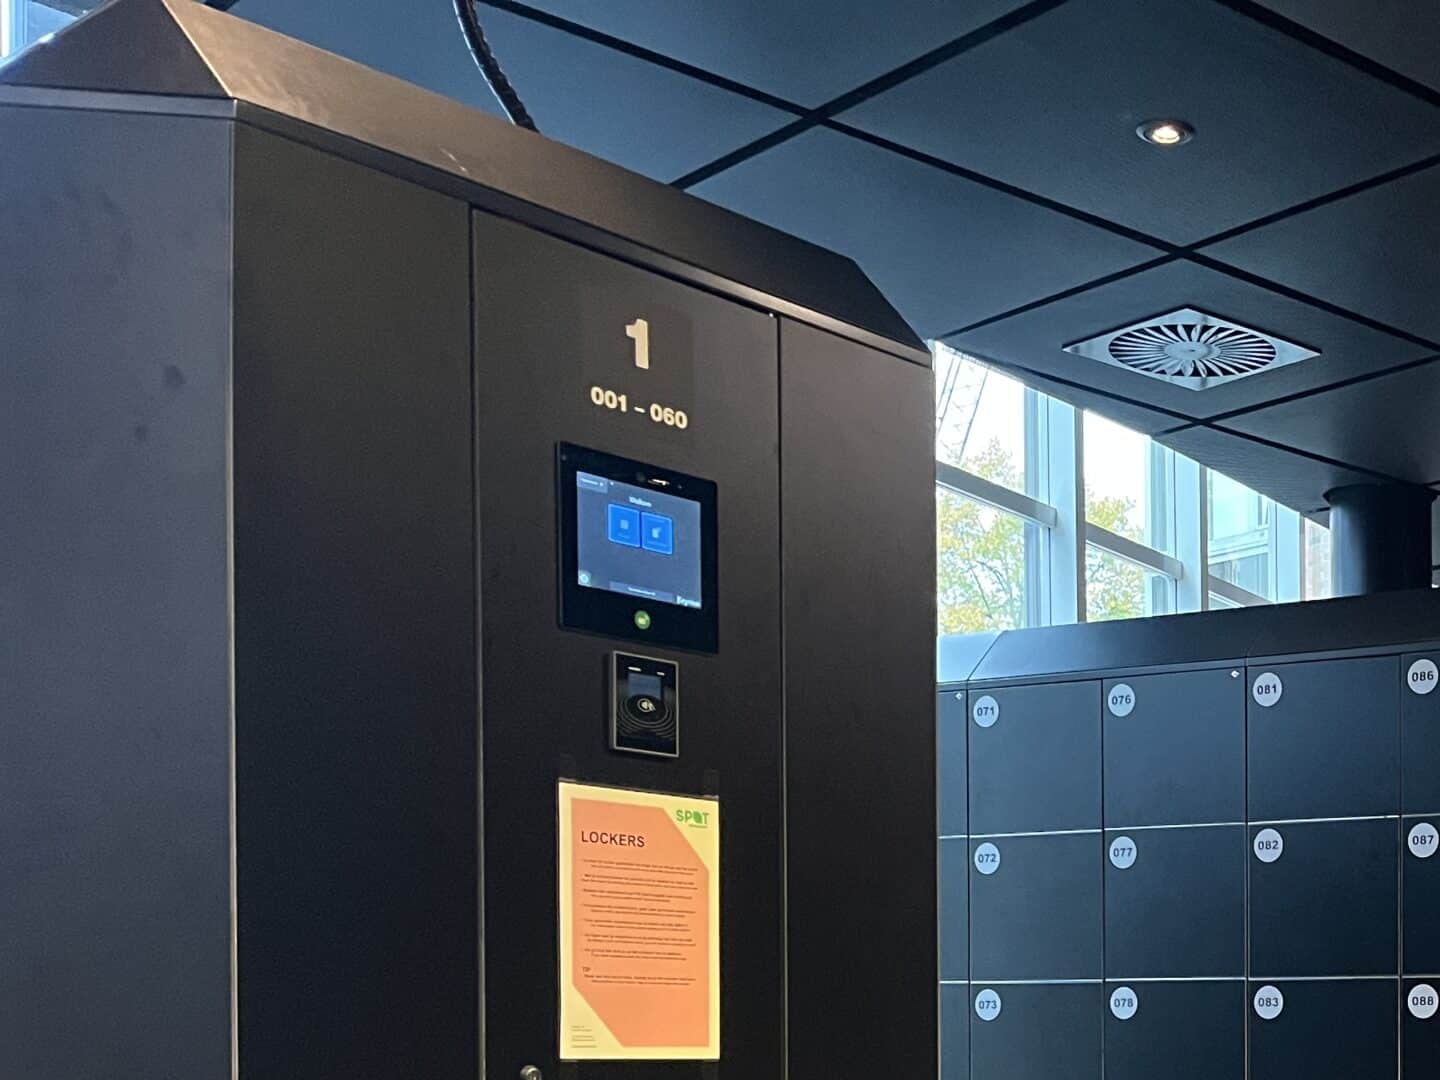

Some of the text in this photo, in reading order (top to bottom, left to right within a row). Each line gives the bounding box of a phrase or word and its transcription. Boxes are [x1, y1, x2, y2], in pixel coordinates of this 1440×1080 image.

[624, 318, 650, 370] 1
[590, 386, 628, 413] 001
[649, 403, 689, 429] 060
[1412, 670, 1434, 683] 086
[1256, 683, 1277, 696] 081
[1111, 695, 1132, 705] 076
[976, 706, 995, 717] 071
[581, 830, 645, 848] LOCKERS
[1257, 839, 1278, 851] 082
[1412, 834, 1434, 846] 087
[978, 853, 997, 864] 072
[1112, 847, 1133, 858] 077
[978, 999, 998, 1010] 073
[1113, 997, 1134, 1008] 078
[1257, 997, 1278, 1008] 083
[1412, 995, 1434, 1007] 088
